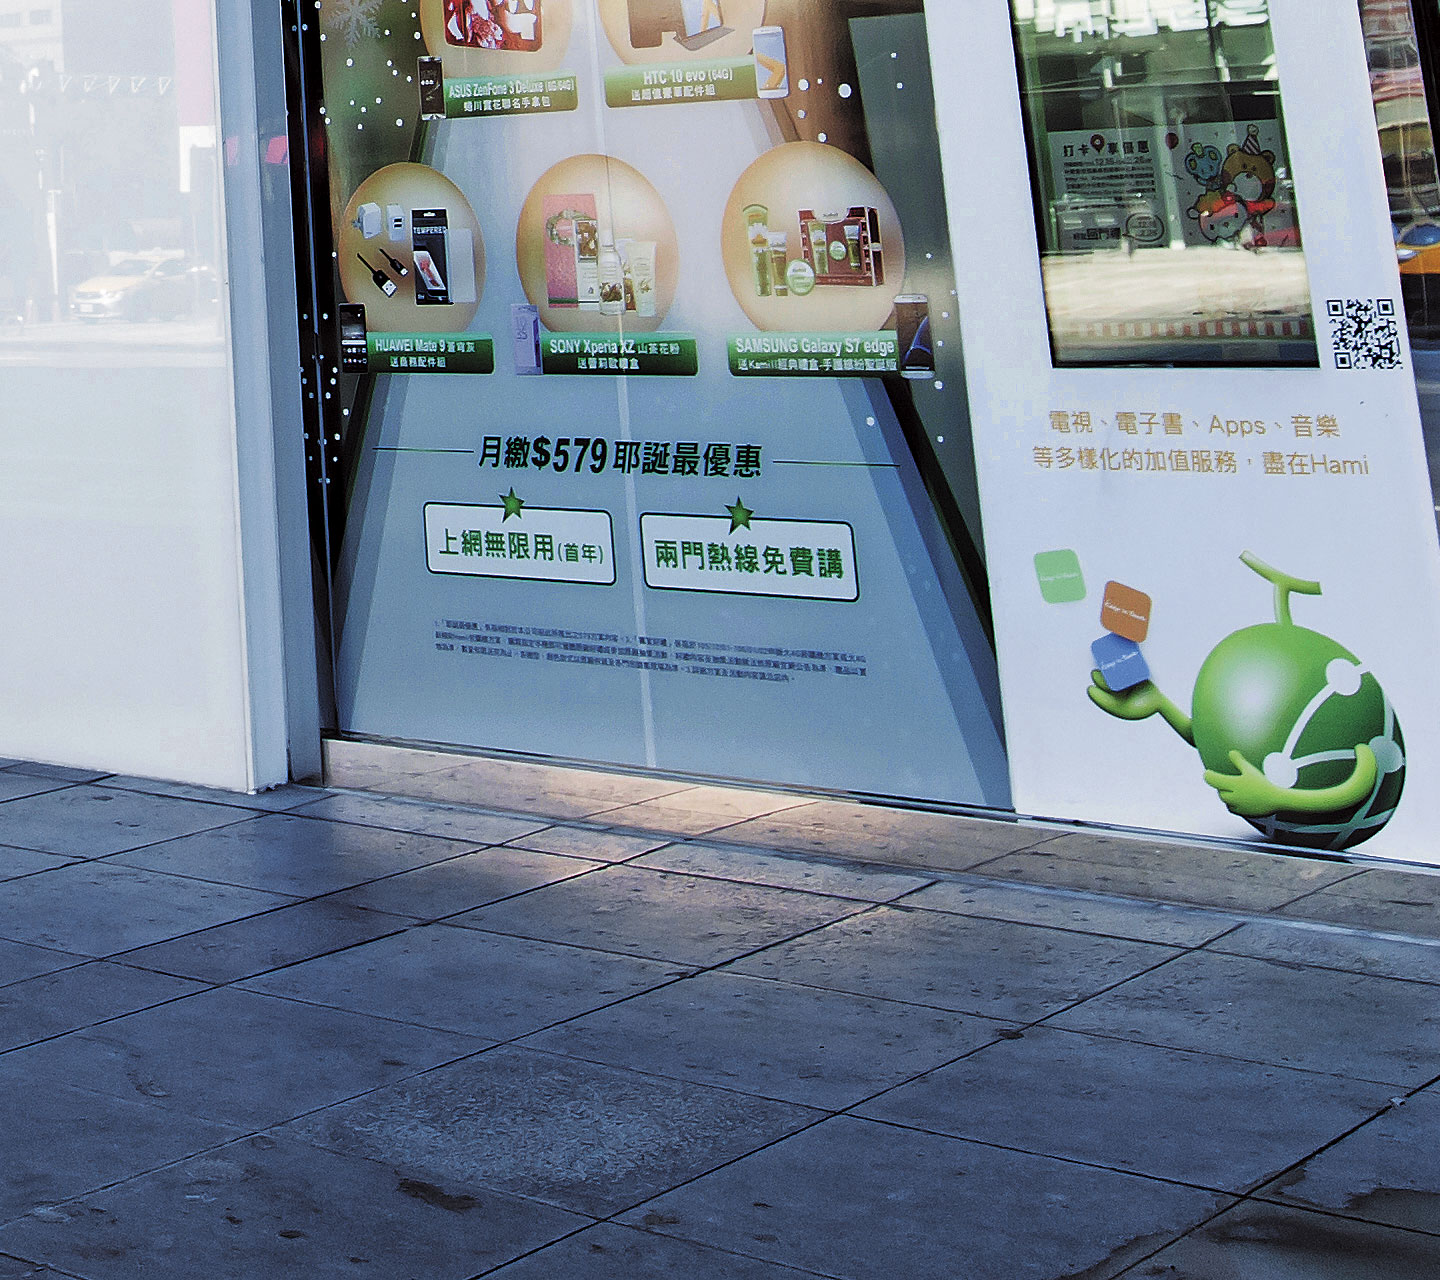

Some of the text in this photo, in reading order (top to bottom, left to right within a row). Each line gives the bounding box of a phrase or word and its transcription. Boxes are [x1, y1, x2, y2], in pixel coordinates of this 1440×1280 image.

[642, 69, 669, 86] HTC
[670, 68, 684, 85] 10
[685, 69, 707, 84] evo
[448, 81, 472, 100] ASUS
[374, 337, 414, 353] HUAWEI
[549, 338, 580, 355] SONY
[582, 338, 619, 357] Xperia
[619, 337, 636, 354] XZ
[736, 337, 799, 354] SAMSUNG
[801, 337, 843, 357] Galaxy
[863, 338, 896, 357] edge
[1047, 410, 1342, 441] 電視、電子書、Apps、音樂
[477, 434, 764, 480] 月繳$579 耶誕最優惠
[652, 539, 845, 582] 兩門熱線免費講
